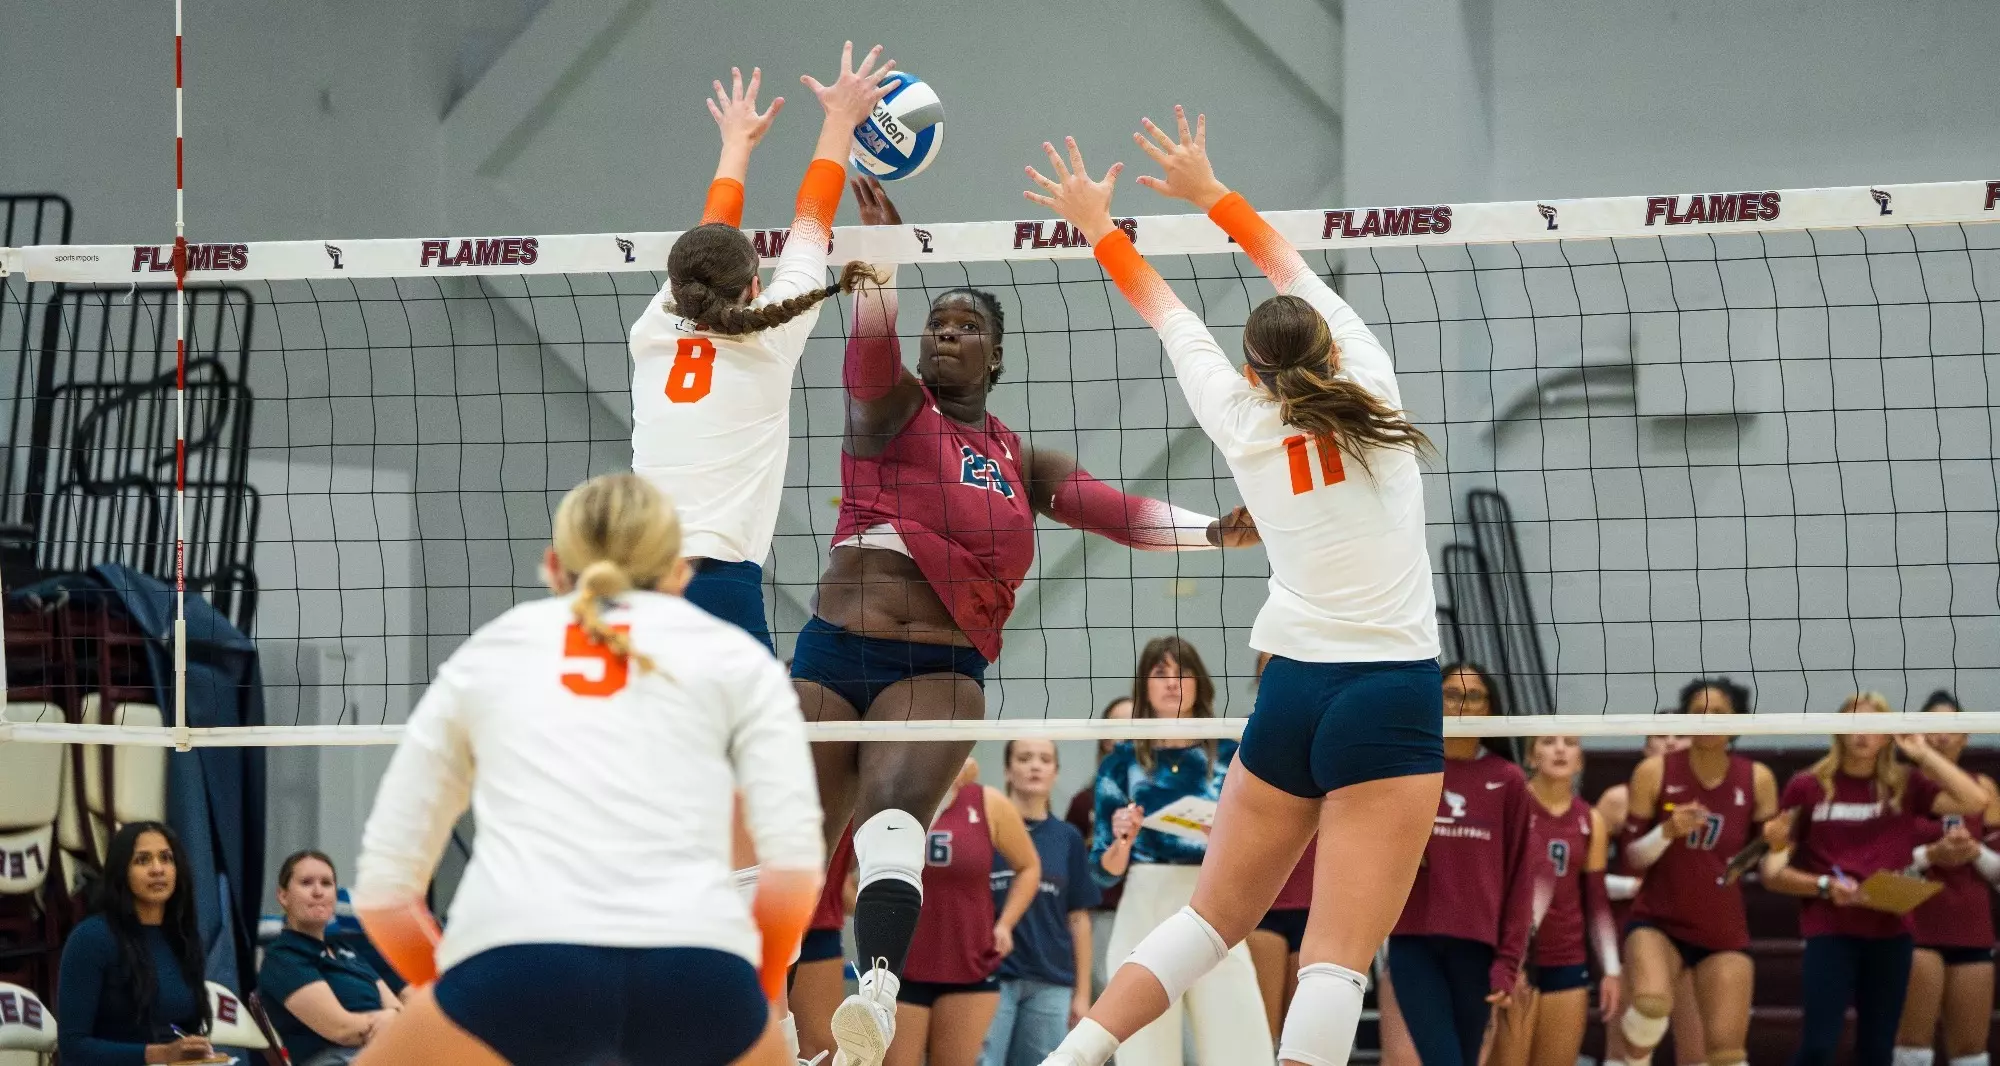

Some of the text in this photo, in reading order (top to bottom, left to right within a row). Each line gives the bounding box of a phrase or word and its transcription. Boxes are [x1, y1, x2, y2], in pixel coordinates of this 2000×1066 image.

[857, 123, 887, 154] CAA
[872, 105, 906, 145] olten
[1321, 204, 1453, 240] FLAMES
[1644, 190, 1782, 226] FLAMES
[1013, 217, 1138, 250] FLAS
[54, 254, 75, 263] sports
[419, 236, 539, 268] FLAMES
[663, 337, 717, 404] 8
[1282, 430, 1347, 496] 11
[560, 623, 631, 698] 5
[926, 830, 953, 867] 6
[1547, 838, 1570, 877] 9
